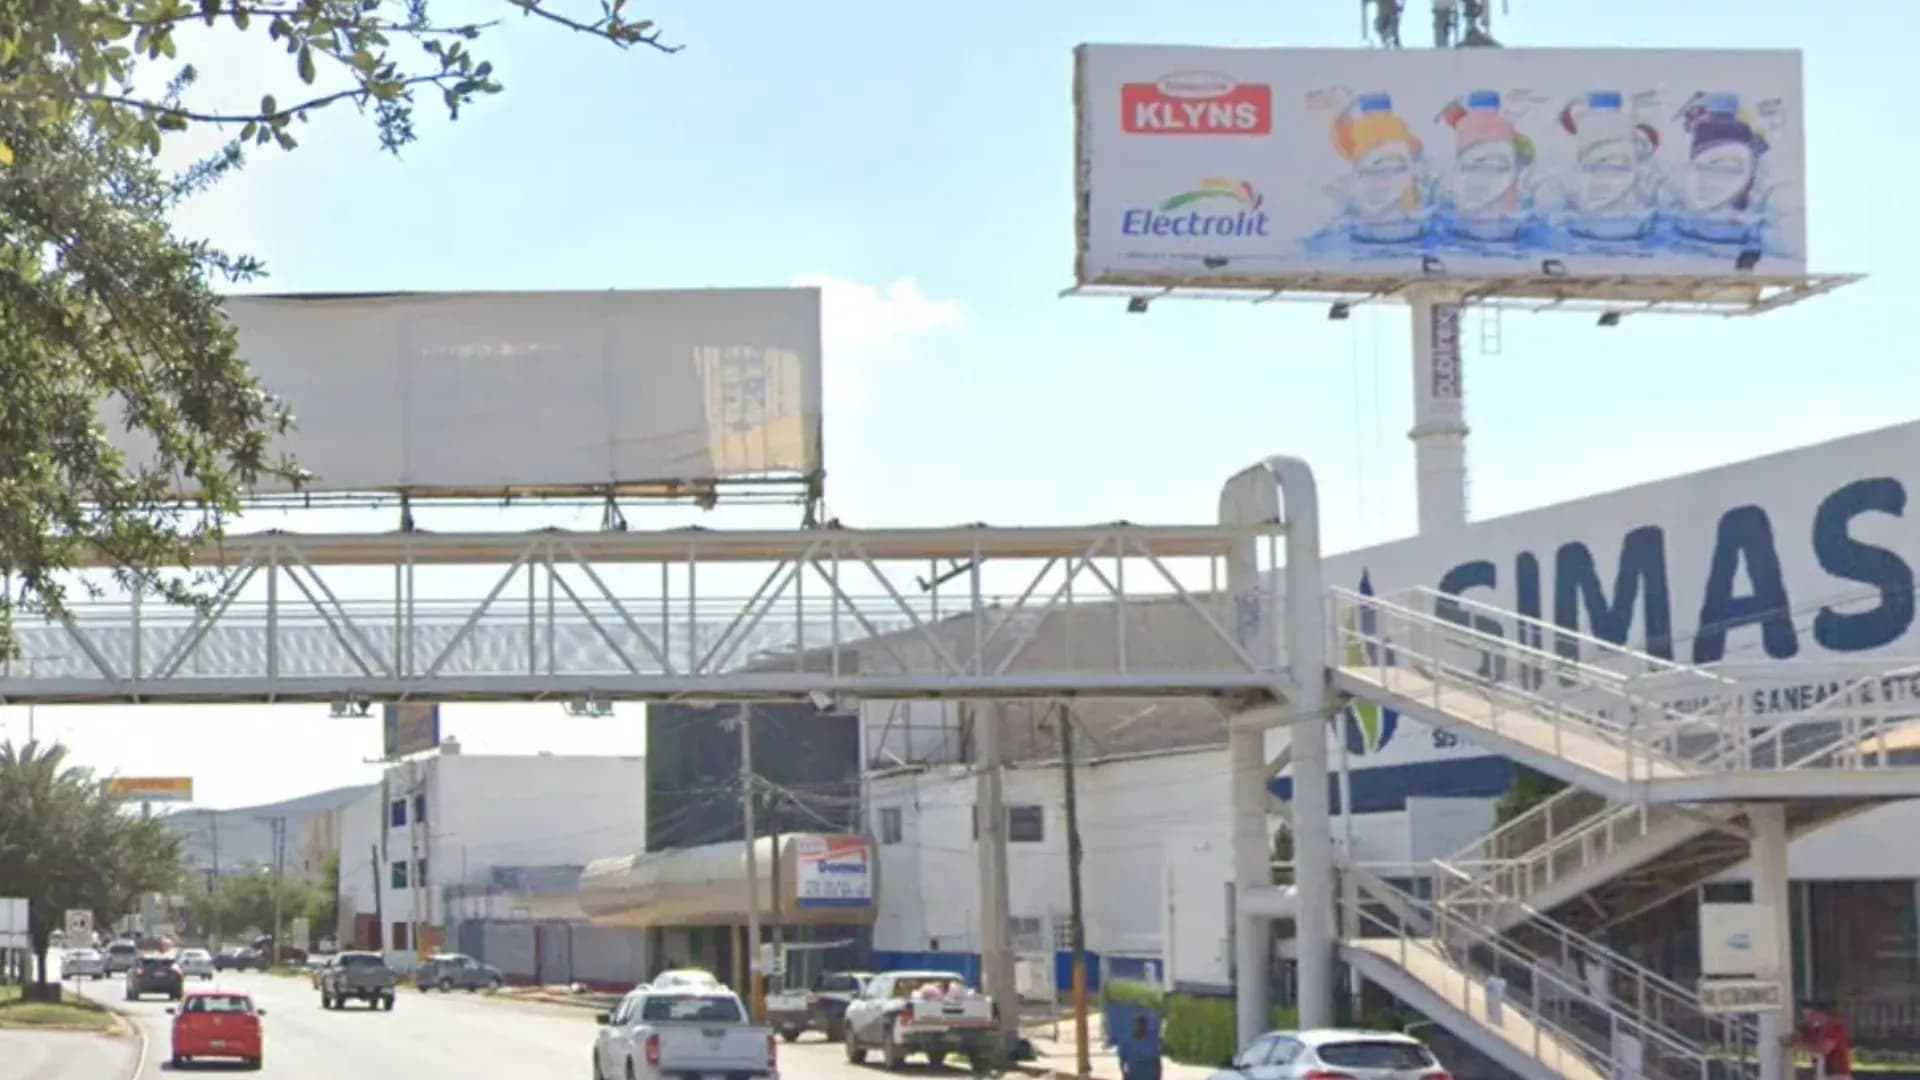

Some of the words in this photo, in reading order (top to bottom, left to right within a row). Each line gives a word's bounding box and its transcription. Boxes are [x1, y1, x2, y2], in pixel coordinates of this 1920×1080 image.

[1135, 102, 1258, 129] KLYNS
[1121, 209, 1270, 237] Electrolit
[1436, 475, 1916, 691] SIMAS
